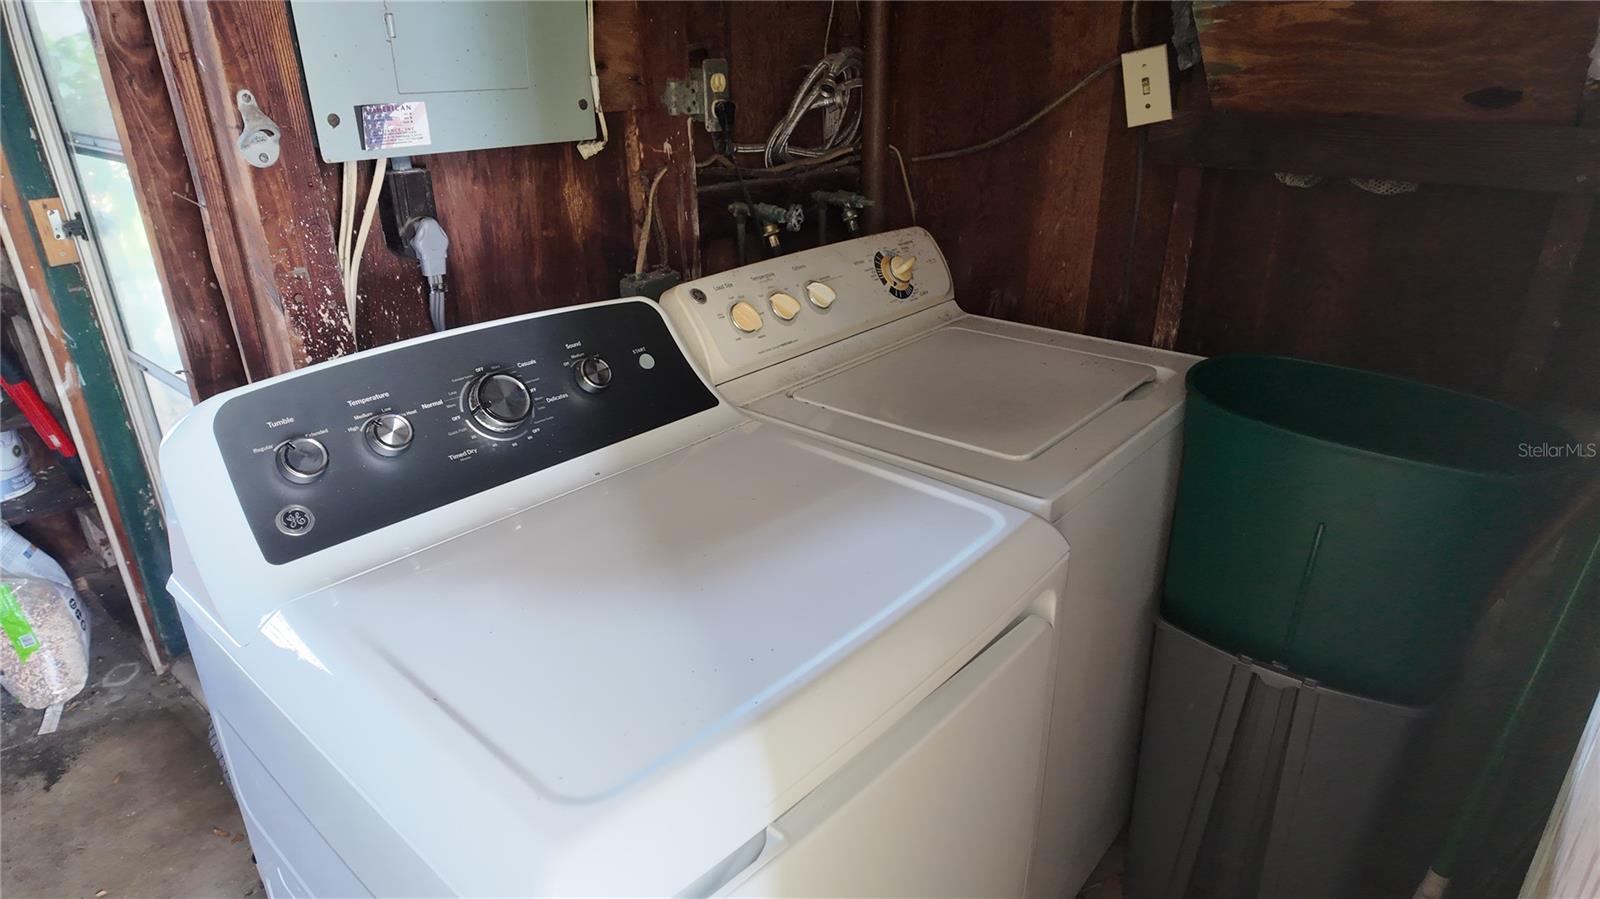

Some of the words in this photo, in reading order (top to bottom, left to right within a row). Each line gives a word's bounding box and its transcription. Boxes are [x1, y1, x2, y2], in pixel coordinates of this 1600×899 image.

[565, 341, 582, 350] Sound
[516, 359, 537, 368] Casuals
[346, 392, 390, 407] Temperature
[545, 393, 569, 403] Delicates
[421, 399, 444, 410] Normal
[266, 417, 295, 428] Tumble
[448, 451, 468, 461] Timed
[467, 449, 478, 457] Dry
